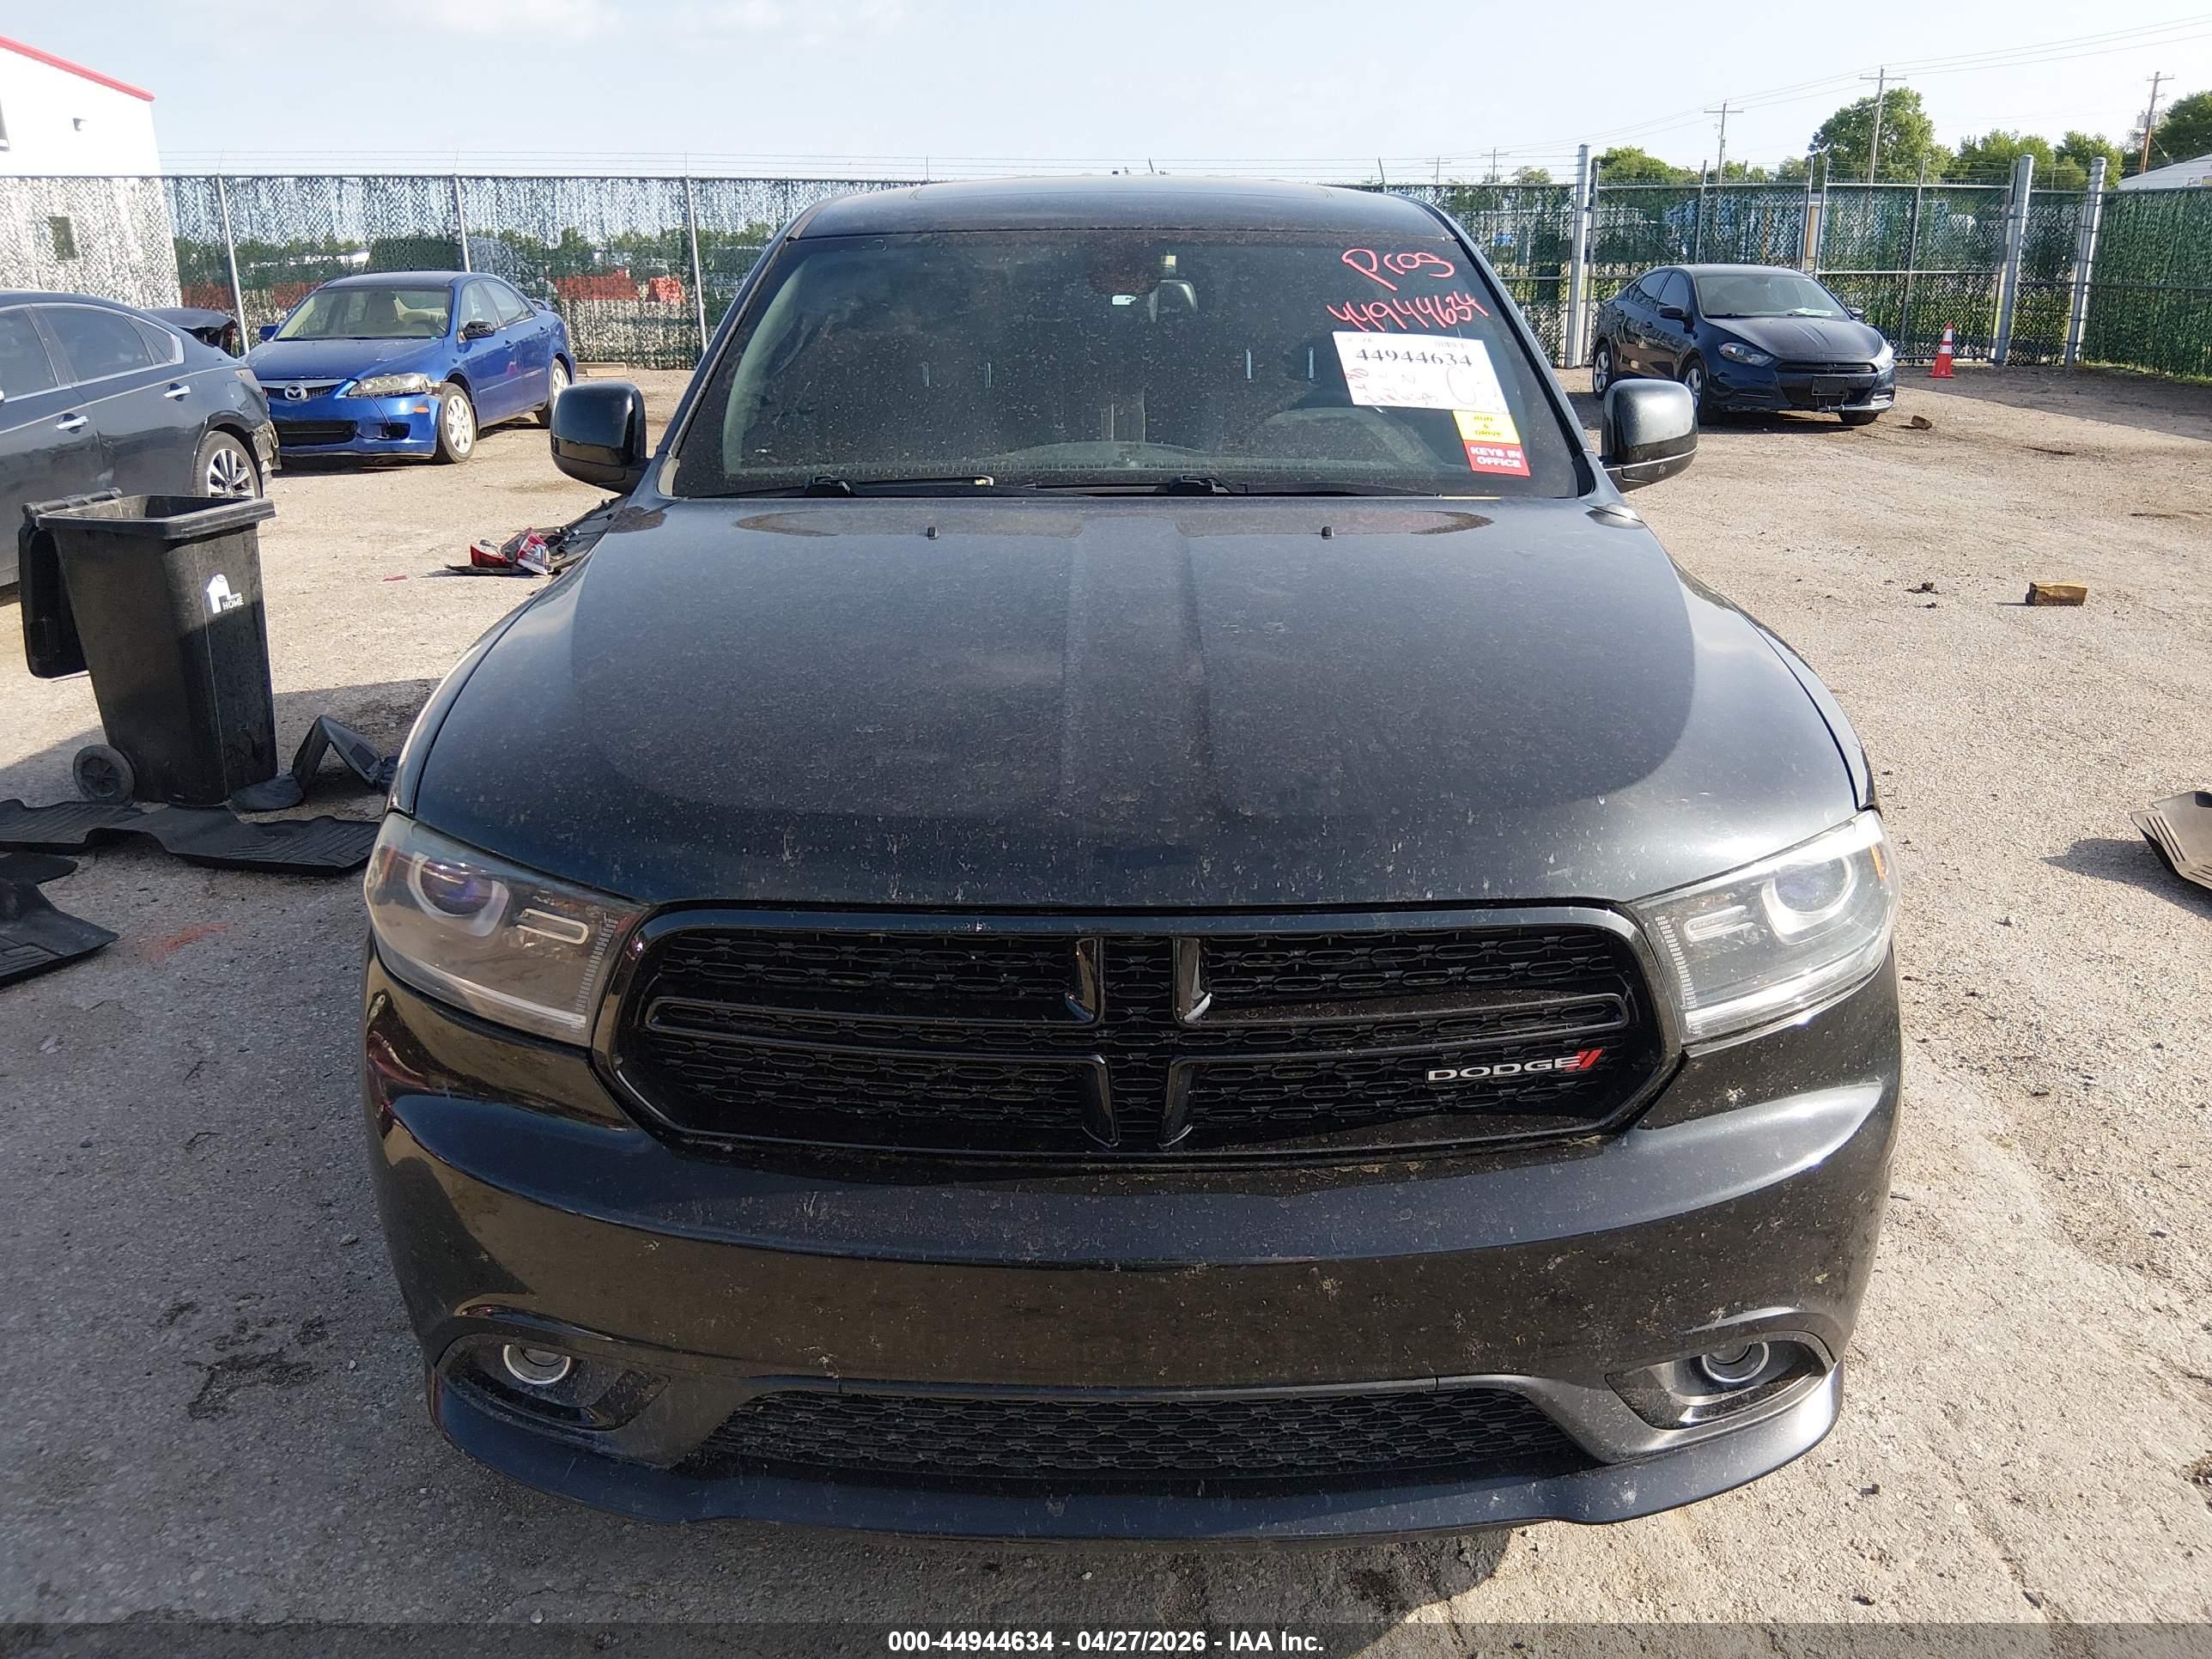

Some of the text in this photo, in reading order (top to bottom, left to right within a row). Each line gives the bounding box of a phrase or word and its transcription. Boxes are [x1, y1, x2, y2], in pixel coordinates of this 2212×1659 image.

[1326, 290, 1489, 332] 44944634
[1356, 349, 1473, 367] 44944634
[1469, 446, 1522, 459] KEYS IN
[1476, 456, 1522, 468] OFFICE
[222, 597, 244, 611] HOME
[1428, 1055, 1582, 1081] DODGE
